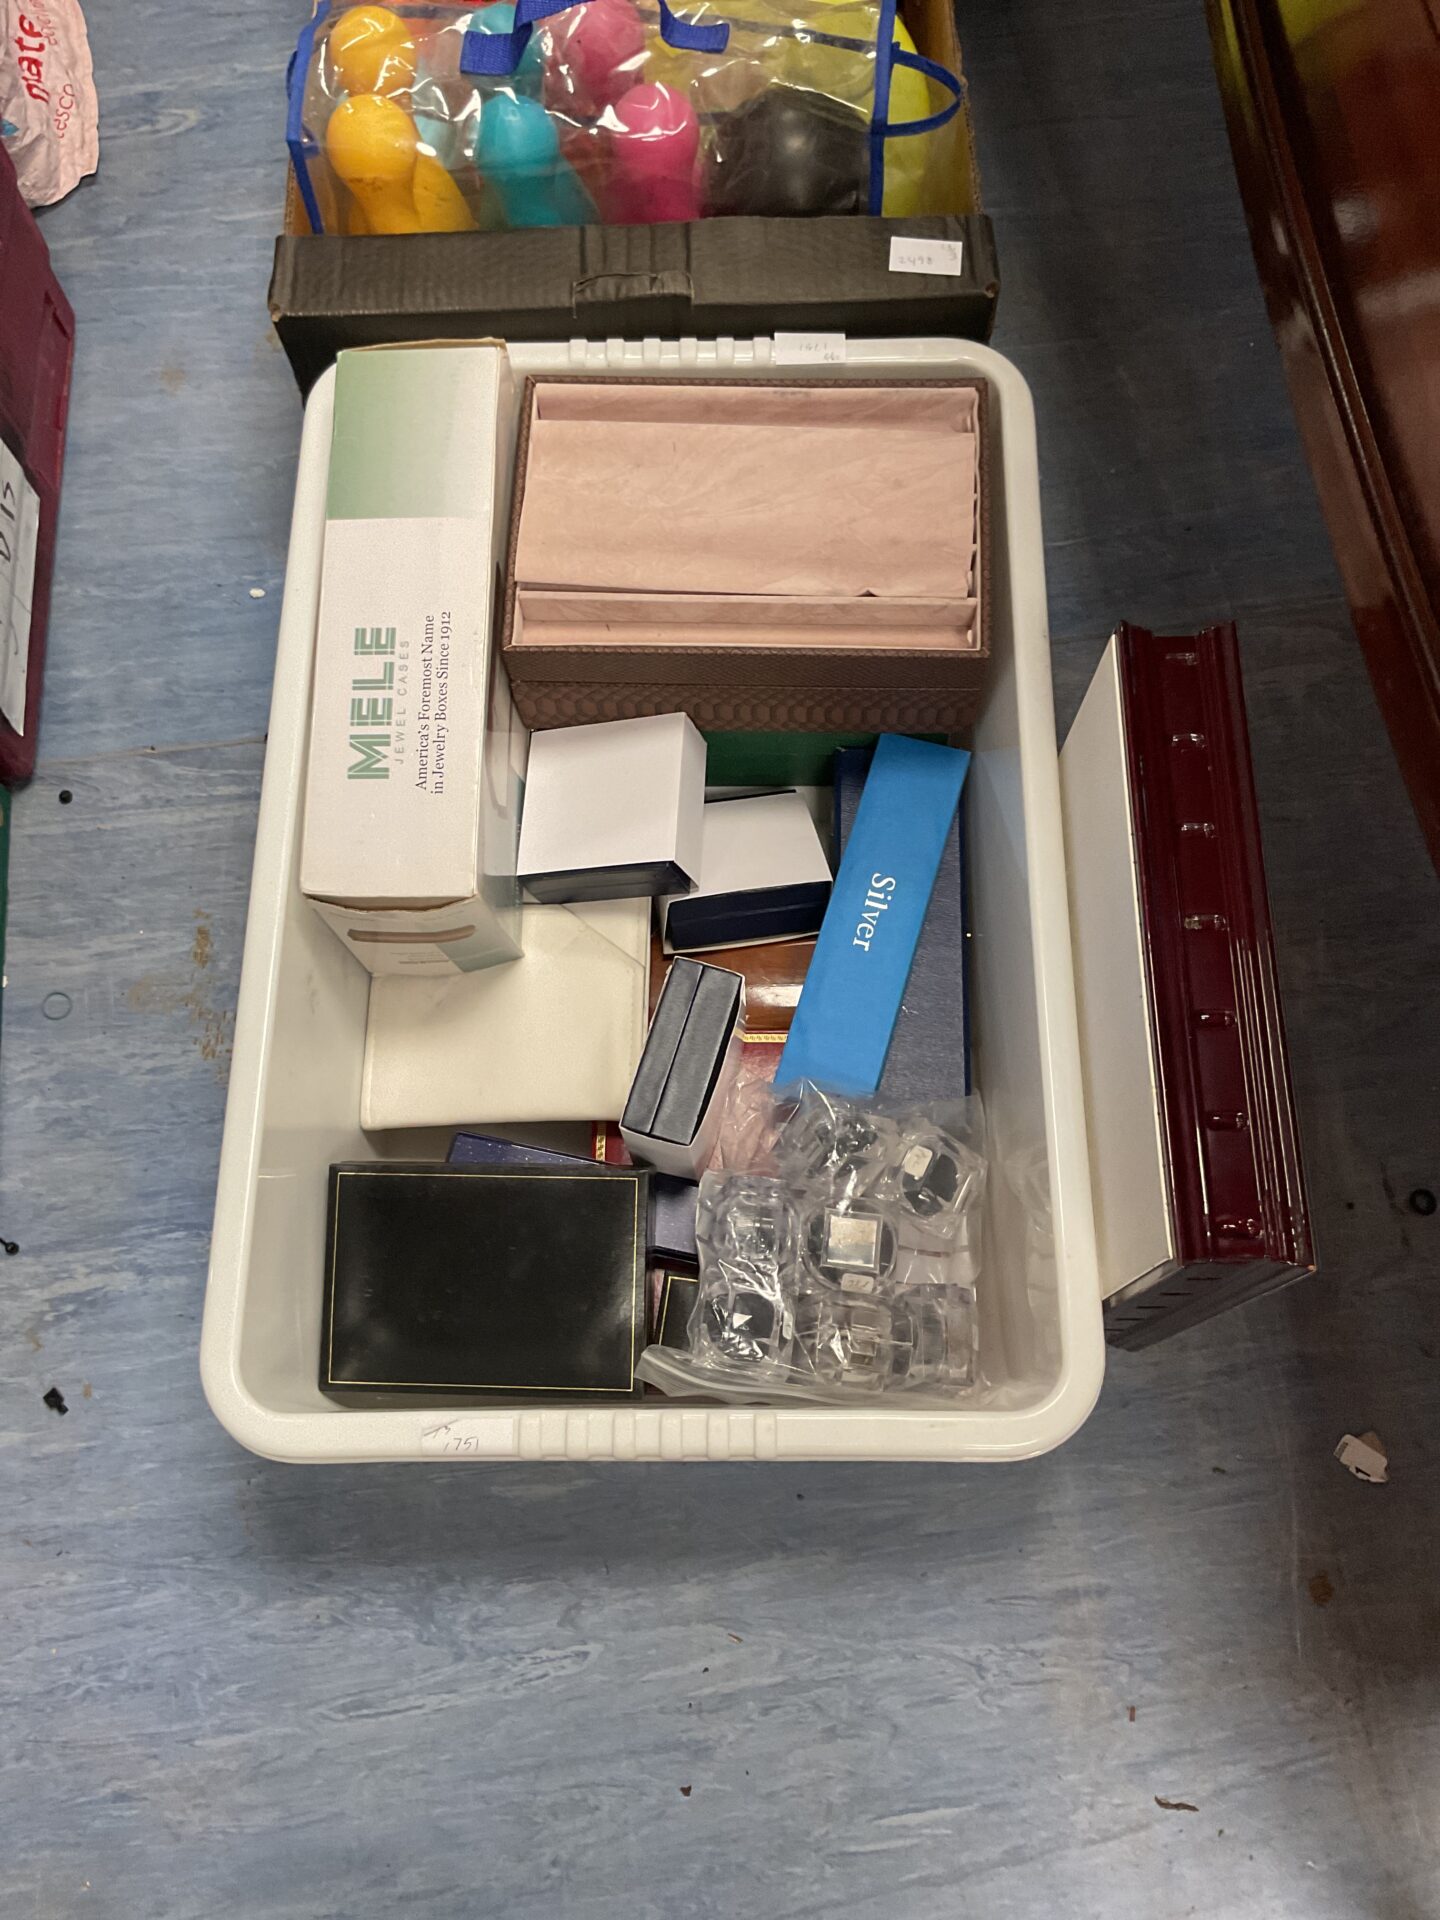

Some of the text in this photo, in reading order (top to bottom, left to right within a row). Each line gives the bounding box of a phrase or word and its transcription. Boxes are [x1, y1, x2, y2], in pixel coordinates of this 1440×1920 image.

[347, 627, 397, 780] MELE
[394, 640, 410, 765] JEWEL CASES
[415, 615, 435, 791] America's Foremost Name
[430, 611, 452, 795] in Jewelry Boxes Since 1912
[853, 872, 896, 952] Silver
